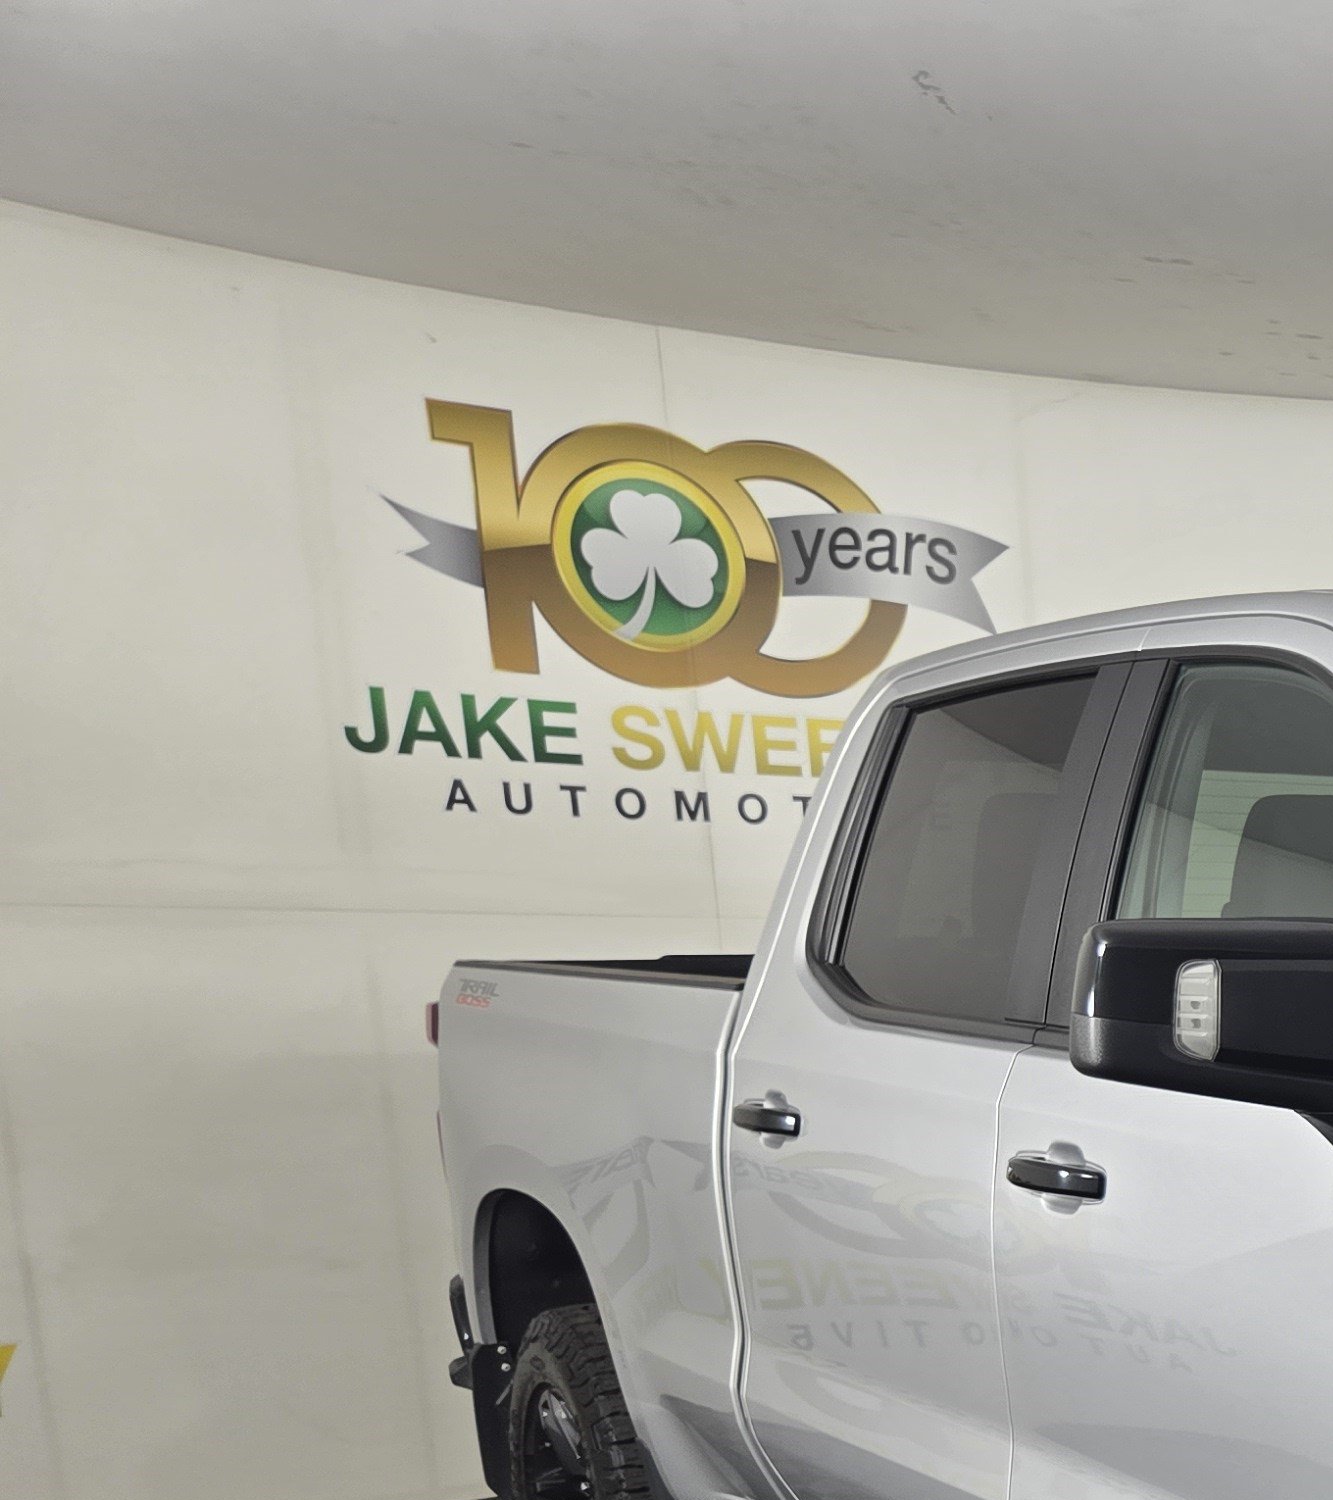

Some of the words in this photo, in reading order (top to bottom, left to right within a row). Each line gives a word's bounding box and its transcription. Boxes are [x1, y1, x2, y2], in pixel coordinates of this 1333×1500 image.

[424, 397, 908, 698] 100
[790, 525, 958, 586] years
[344, 686, 584, 766] JAKE
[610, 705, 847, 778] SWEE
[444, 778, 812, 825] AUTOMOT
